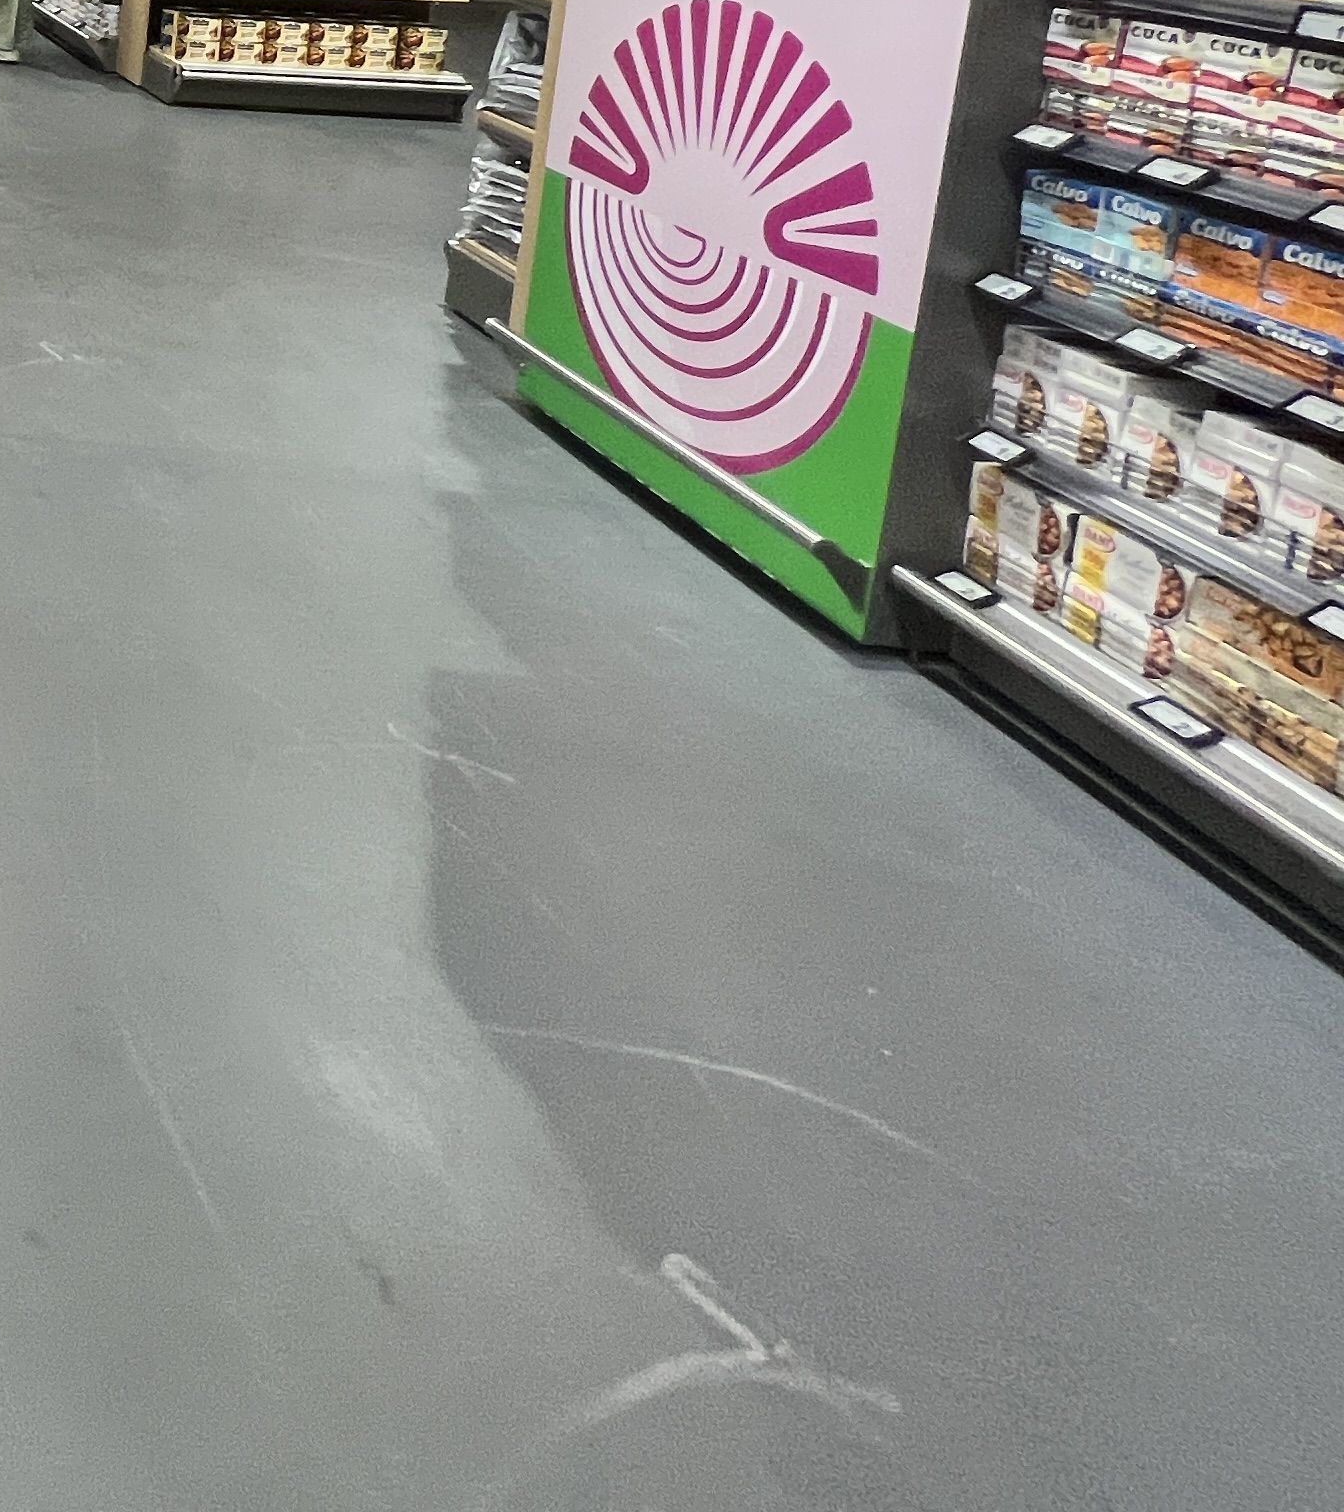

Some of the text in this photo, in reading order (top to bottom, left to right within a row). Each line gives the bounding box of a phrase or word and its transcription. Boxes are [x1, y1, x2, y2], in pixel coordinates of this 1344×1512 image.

[1053, 12, 1096, 31] CUCA
[1130, 25, 1179, 45] CUCA
[1210, 38, 1262, 58] CUCA
[1300, 54, 1344, 76] CUC
[1030, 174, 1089, 204] Calvo
[1112, 195, 1163, 225] Calvo
[1190, 217, 1254, 250] Calvo
